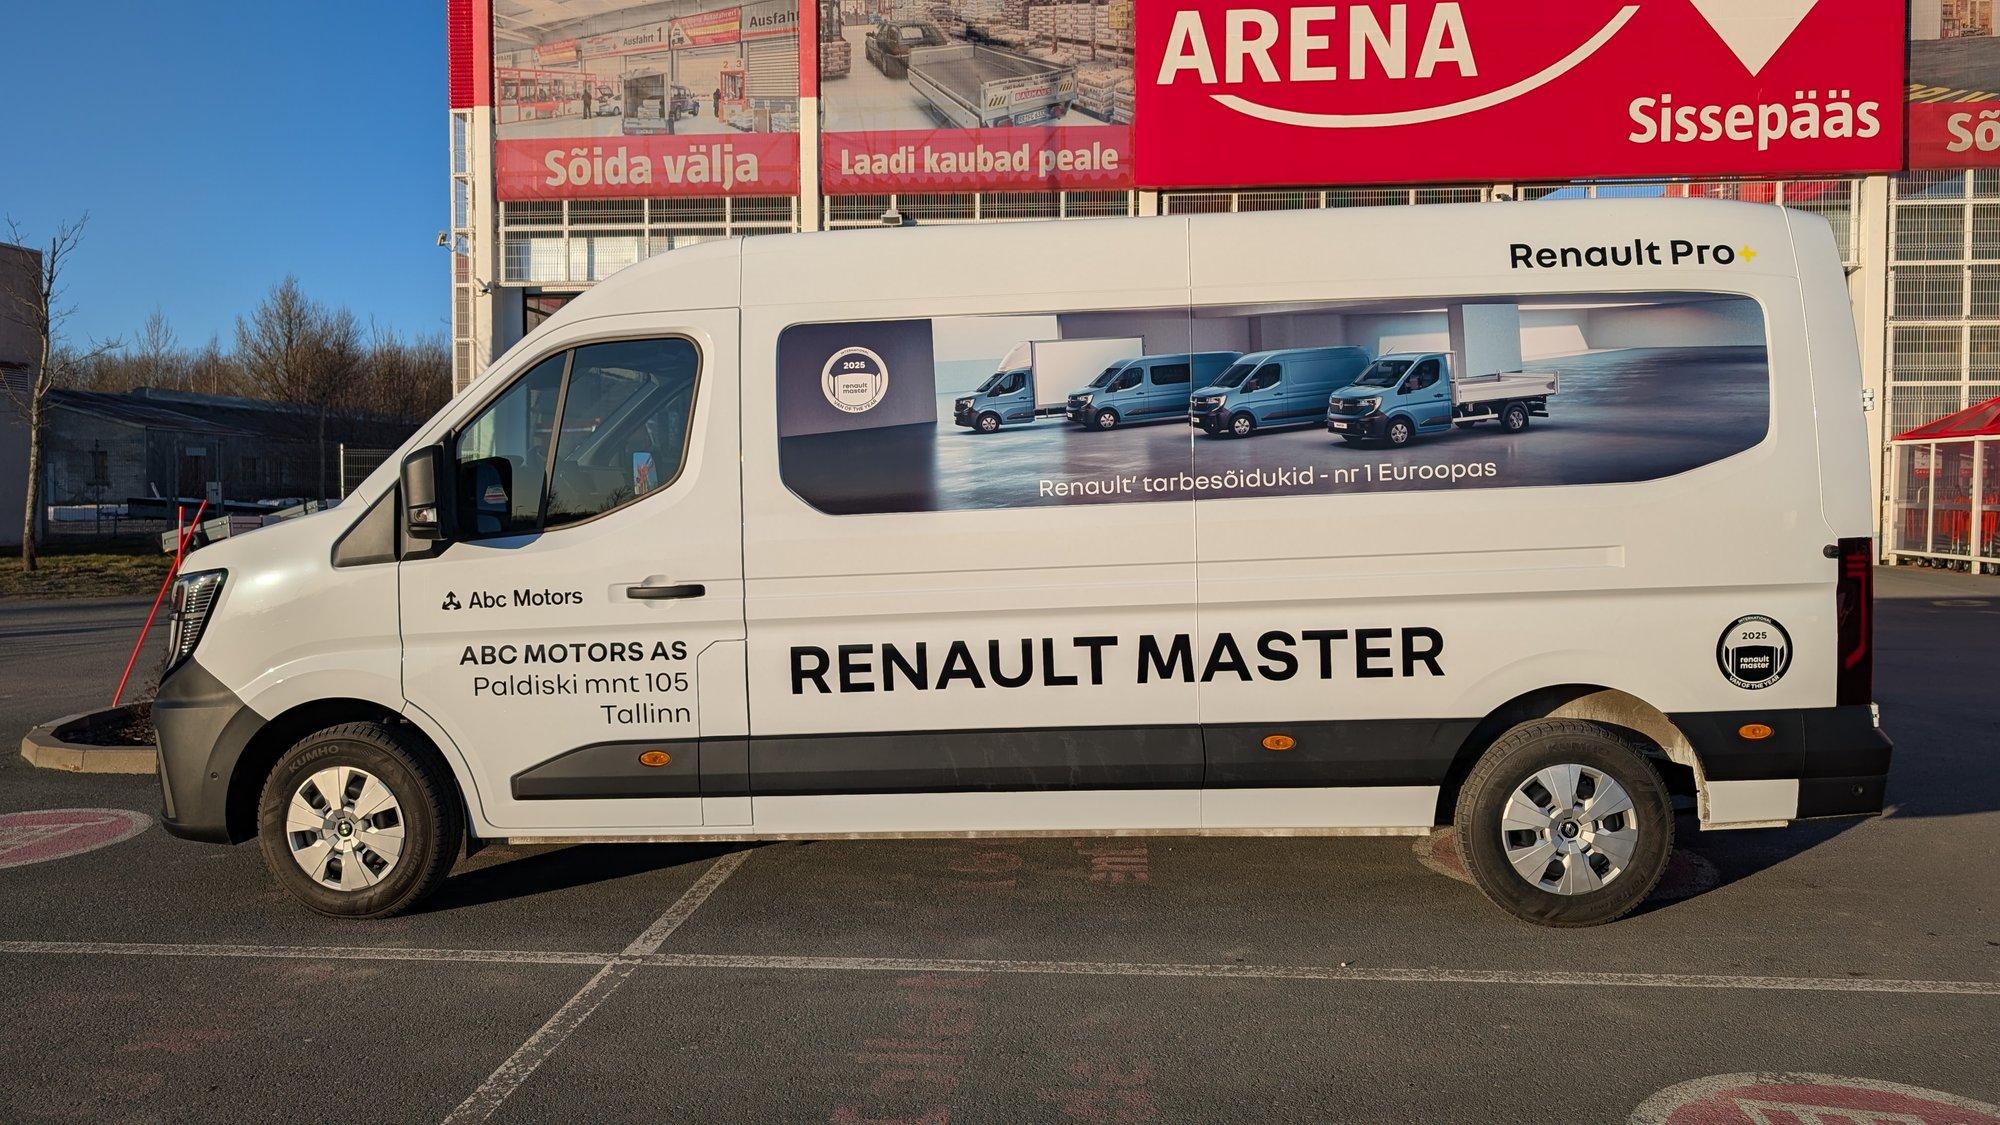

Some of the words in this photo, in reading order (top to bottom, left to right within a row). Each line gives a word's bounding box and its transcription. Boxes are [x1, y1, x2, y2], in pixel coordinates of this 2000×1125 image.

[623, 33, 654, 47] Ausfahrt
[656, 27, 662, 42] 1
[1157, 2, 1478, 84] ARENA
[1629, 90, 1880, 151] Sissepääs
[1947, 110, 2000, 152] Sõ
[545, 147, 652, 187] Sõida
[663, 144, 759, 191] välja
[841, 146, 915, 175] Laadi
[924, 143, 1030, 174] kaubad
[1038, 142, 1119, 178] peale
[1510, 238, 1662, 269] Renault
[843, 361, 865, 369] 2025
[834, 400, 844, 410] VAN
[864, 399, 877, 410] YEAR
[1143, 465, 1314, 492] tarbesõidukid
[1335, 469, 1360, 483] nr
[1364, 464, 1372, 482] 1
[1379, 462, 1497, 483] Euroopas
[469, 590, 507, 609] Abc
[514, 588, 583, 607] Motors
[1742, 631, 1767, 640] 2025
[460, 645, 518, 666] ABC
[524, 641, 644, 664] MOTORS
[650, 640, 688, 661] AS
[790, 635, 1119, 695] RENAULT
[1136, 626, 1446, 684] MASTER
[1740, 655, 1770, 663] renault
[474, 674, 578, 697] Paldiski
[585, 675, 640, 694] mnt
[645, 673, 689, 693] 105
[1729, 675, 1742, 687] VAN
[1764, 674, 1779, 686] YEAR
[600, 702, 691, 725] Tallinn
[288, 745, 340, 773] KUMHO
